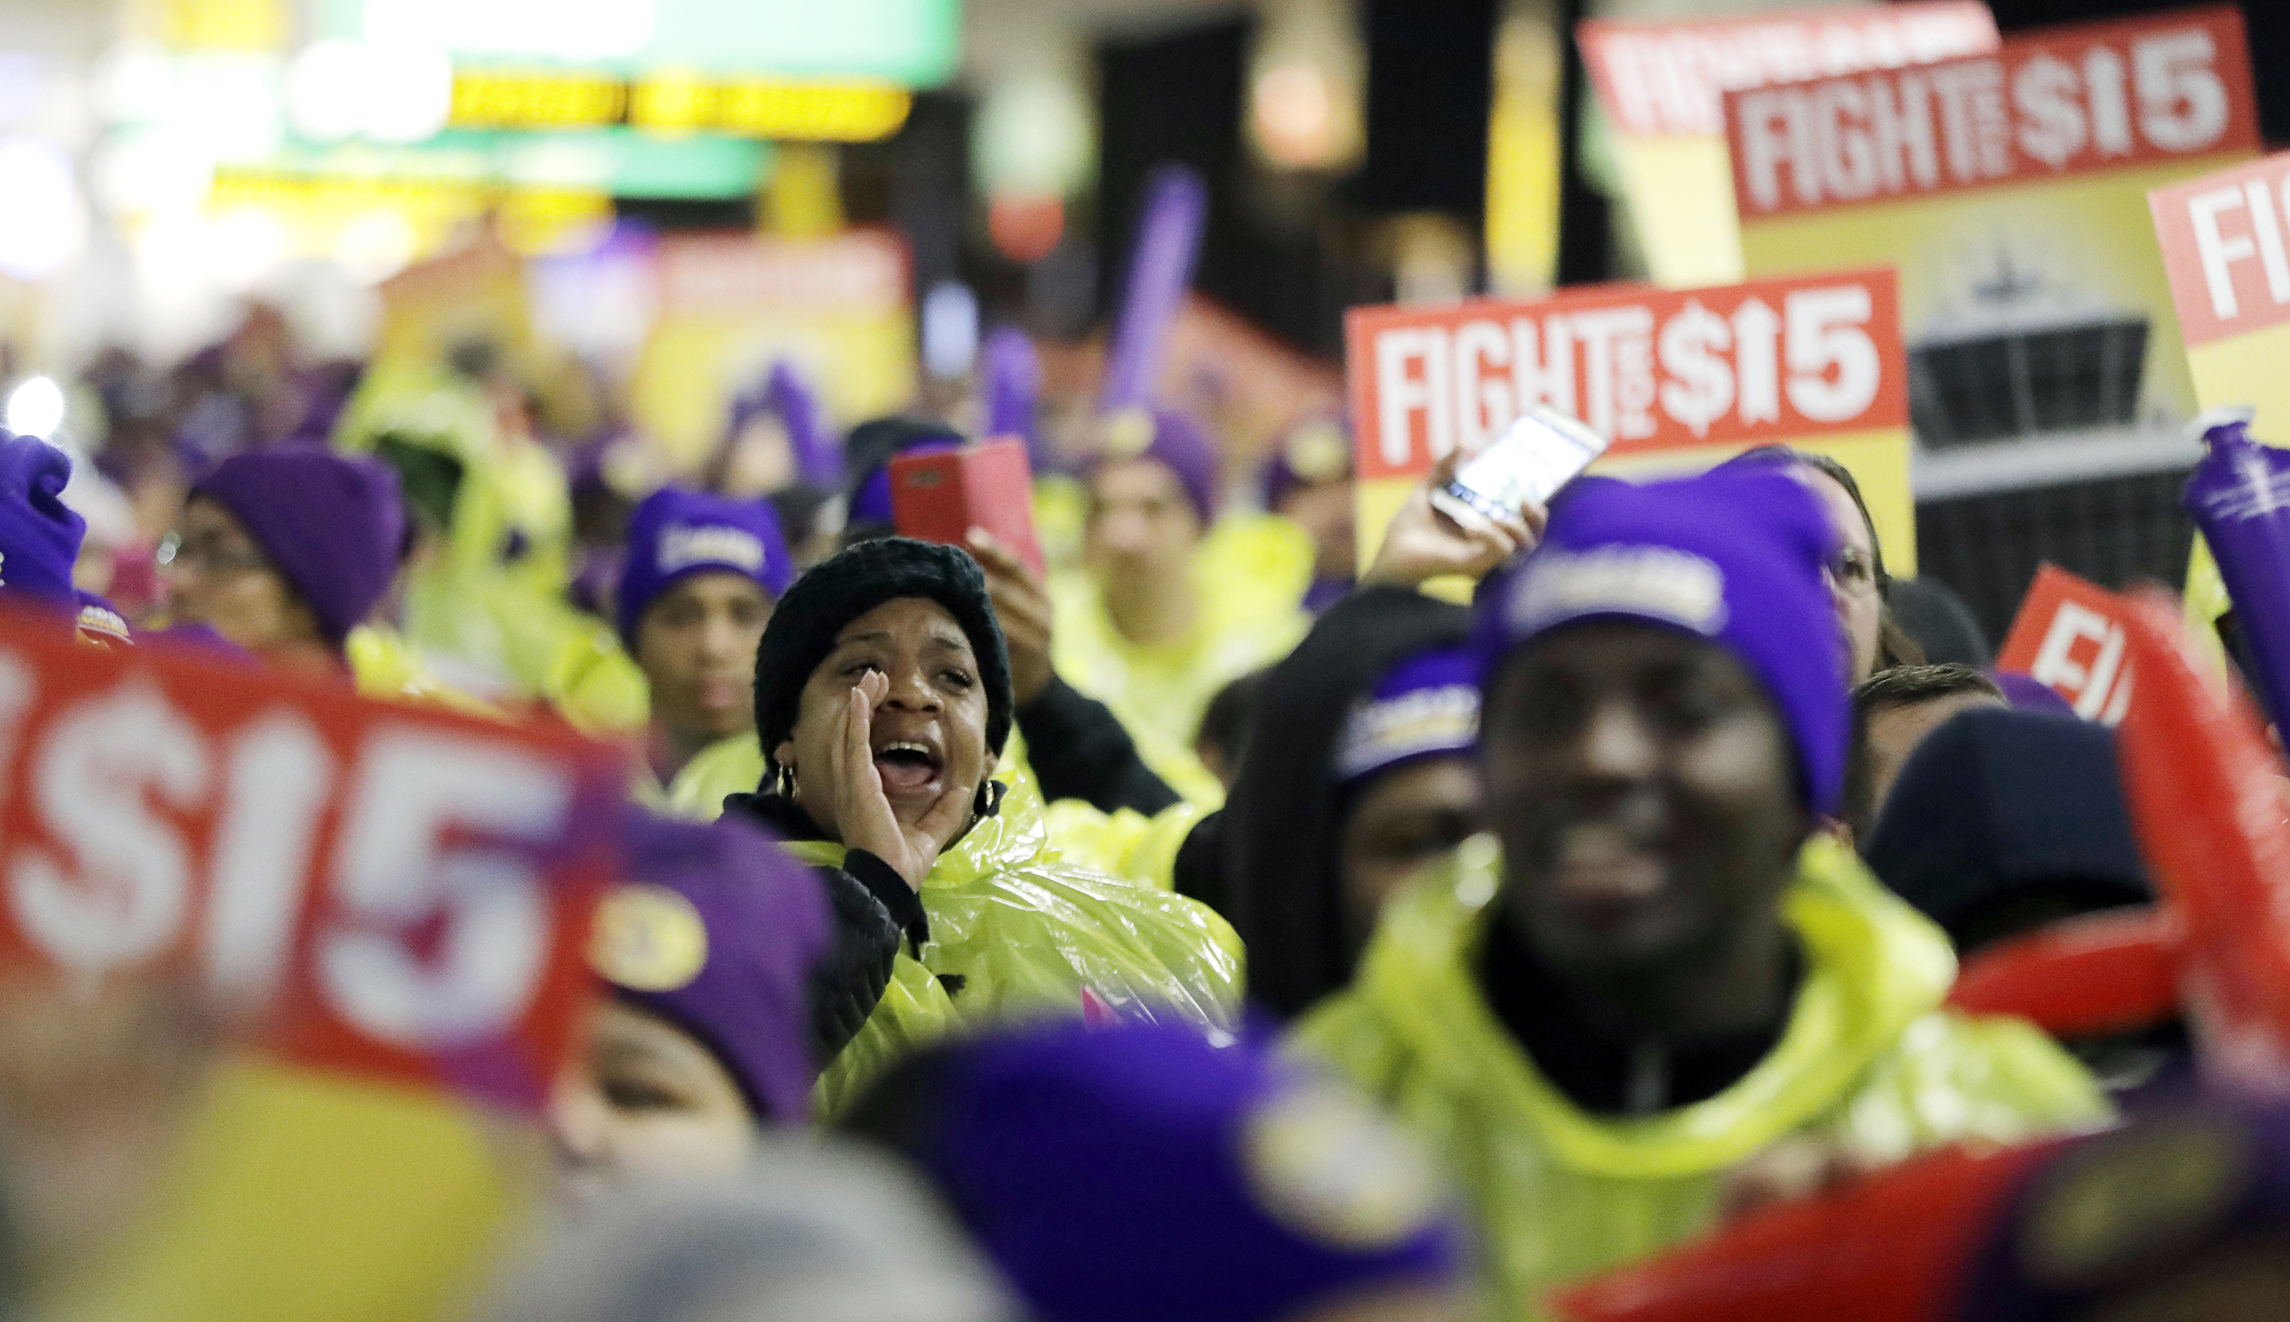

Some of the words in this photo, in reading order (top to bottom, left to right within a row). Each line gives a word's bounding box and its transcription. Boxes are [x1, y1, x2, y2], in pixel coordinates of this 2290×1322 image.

[1738, 58, 2002, 210] FIGHT
[2012, 28, 2228, 170] $15
[2187, 172, 2290, 320] FI
[1374, 306, 1656, 466] FIGHT
[1658, 284, 1882, 438] $15
[2034, 600, 2136, 728] FI
[6, 670, 574, 1048] $15
